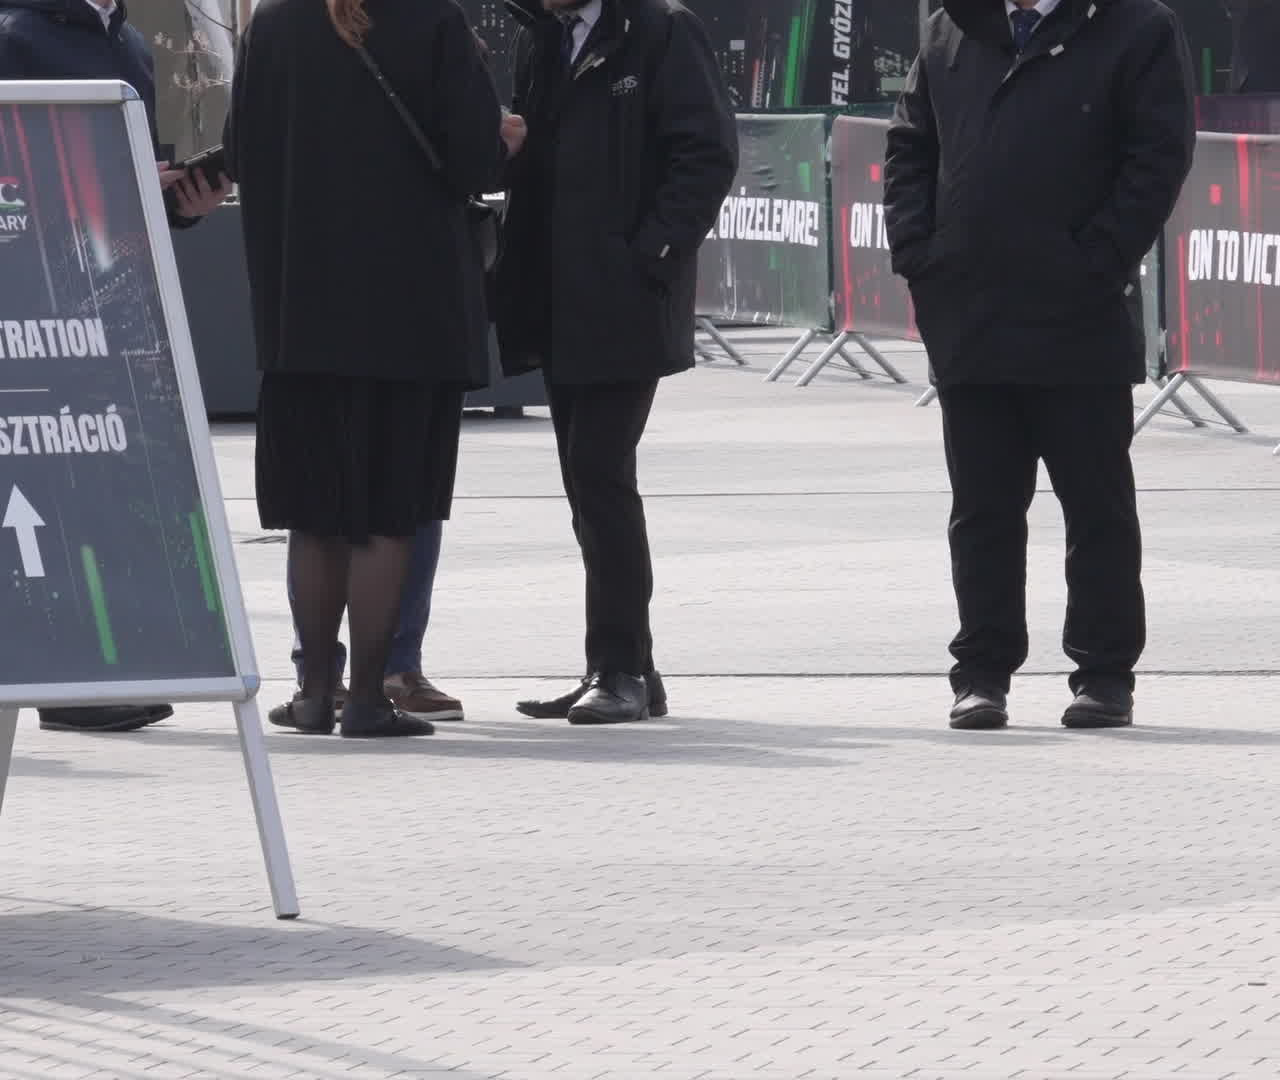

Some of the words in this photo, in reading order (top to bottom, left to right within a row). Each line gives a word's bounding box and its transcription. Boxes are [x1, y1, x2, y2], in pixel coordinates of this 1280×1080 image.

[720, 185, 819, 248] GYŐZELEMRE!
[850, 202, 873, 248] ON
[1188, 228, 1212, 281] ON
[1217, 230, 1239, 281] TO
